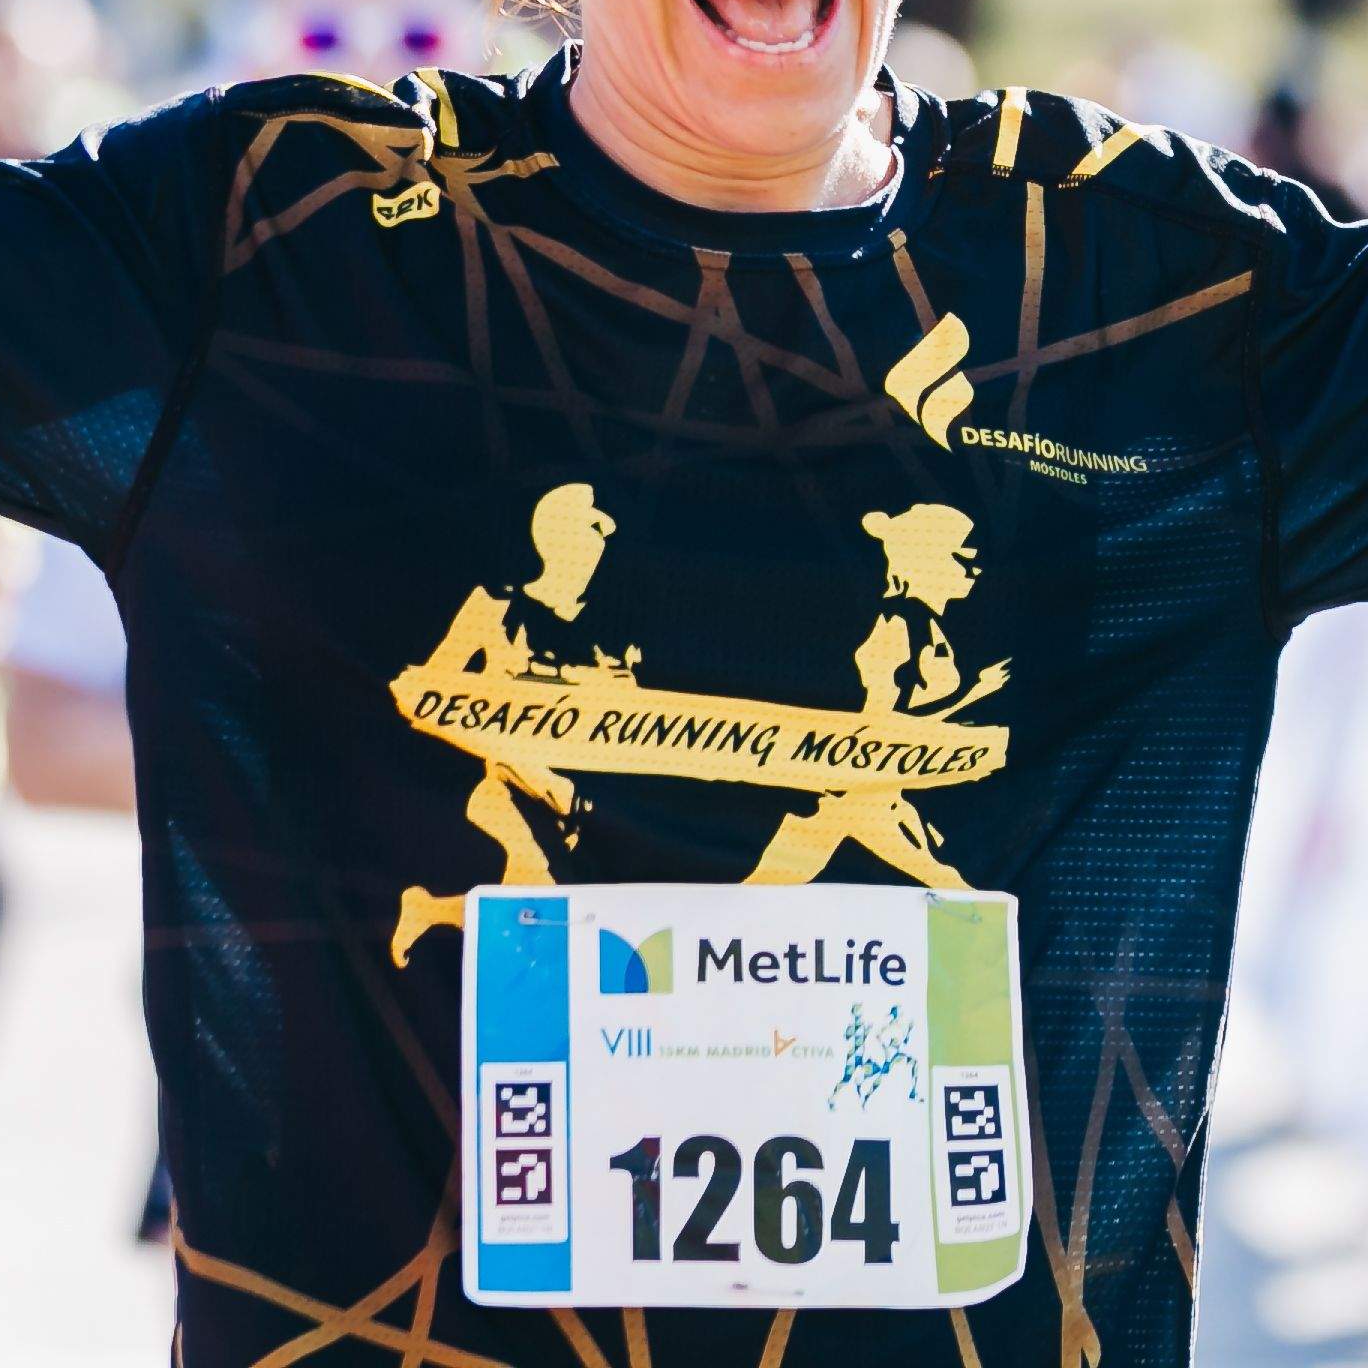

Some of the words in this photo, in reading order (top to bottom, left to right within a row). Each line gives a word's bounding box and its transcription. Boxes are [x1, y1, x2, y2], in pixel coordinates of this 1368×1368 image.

[1030, 460, 1087, 485] MÓSTOLES
[413, 690, 580, 739] DESAFÍO
[588, 710, 781, 767] RUNNING
[790, 725, 990, 775] MÓSTOLES
[696, 938, 907, 986] MetLife
[601, 1027, 652, 1057] VIII
[659, 1045, 700, 1058] 15KM
[707, 1045, 770, 1058] MADRID
[609, 1135, 900, 1264] 1264
